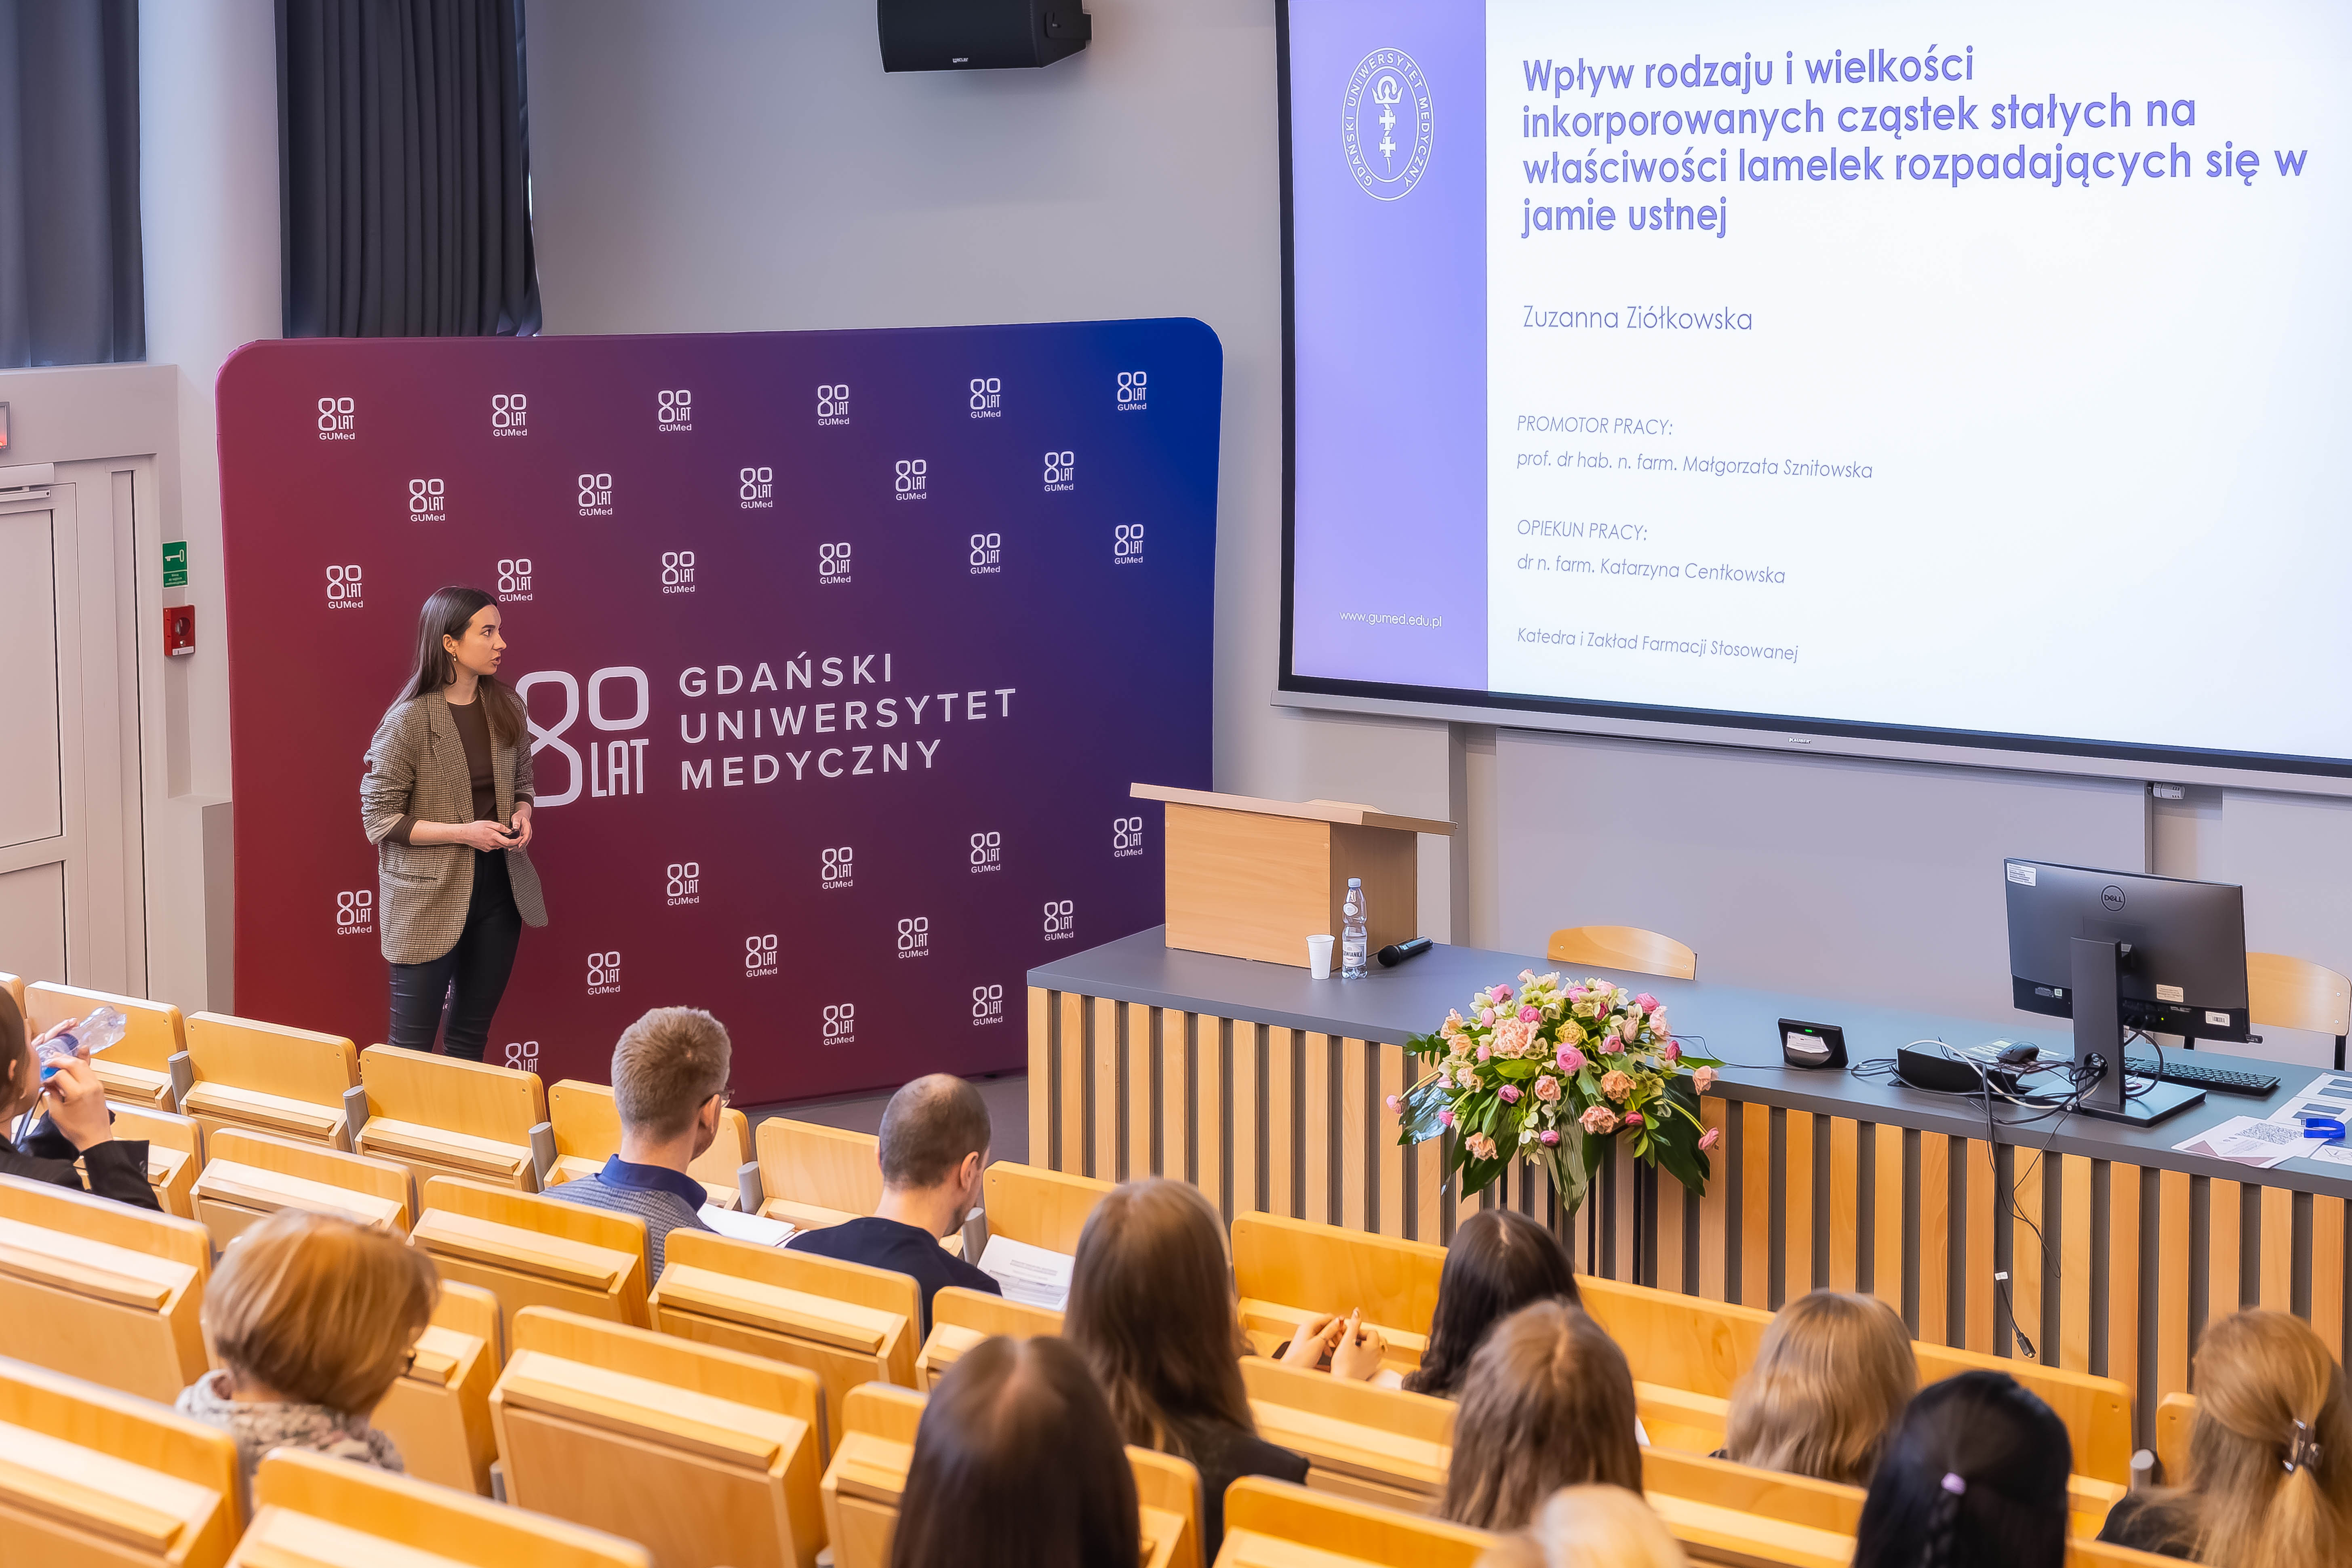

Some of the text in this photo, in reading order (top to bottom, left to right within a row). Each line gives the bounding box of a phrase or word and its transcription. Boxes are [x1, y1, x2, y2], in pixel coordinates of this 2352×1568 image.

[1523, 44, 1973, 99] Wpływ rodzaju i wielkości
[1345, 53, 1430, 187] GDAŃSKI UNIWERSYTET MEDYCZNY
[1523, 92, 2195, 144] inkorporowanych cząstek stałych na
[1522, 141, 2308, 188] właściwości lamelek rozpadających się w
[1521, 196, 1726, 239] jamie ustnej
[1524, 305, 1752, 330] Zuzanna Ziółkowska
[971, 378, 1000, 409] 80
[1118, 372, 1146, 402] 80
[1134, 387, 1146, 400] LAT
[659, 390, 691, 423] 80
[818, 385, 849, 417] 80
[835, 402, 849, 415] LAT
[987, 395, 1000, 408] LAT
[318, 398, 354, 431] 80
[493, 394, 526, 427] 80
[512, 412, 526, 425] LAT
[677, 407, 691, 421] LAT
[339, 415, 354, 429] LAT
[1517, 415, 1672, 435] PROMOTOR PRACY:
[1044, 451, 1074, 483] 80
[1517, 450, 1872, 478] prof. dr hab. n. farm. Małgorzata Sznitowska
[896, 460, 926, 492] 80
[913, 476, 926, 490] LAT
[1061, 468, 1074, 481] LAT
[579, 474, 611, 507] 80
[741, 467, 772, 500] 80
[758, 484, 772, 498] LAT
[409, 479, 444, 512] 80
[429, 497, 444, 511] LAT
[597, 491, 612, 505] LAT
[1518, 520, 1647, 541] OPIEKUN PRACY:
[1115, 524, 1143, 556] 80
[1131, 541, 1143, 554] LAT
[971, 533, 1000, 565] 80
[987, 550, 1000, 563] LAT
[662, 551, 694, 584] 80
[820, 543, 851, 575] 80
[837, 560, 850, 573] LAT
[498, 559, 531, 592] 80
[680, 568, 694, 582] LAT
[1518, 553, 1785, 583] dr n. farm. Katarzyna Centkowska
[326, 565, 361, 599] 80
[517, 577, 531, 590] LAT
[820, 576, 851, 584] GUMed
[347, 583, 362, 597] LAT
[663, 585, 695, 593] GUMed
[328, 600, 363, 608] GUMed
[499, 594, 532, 602] GUMed
[1339, 612, 1442, 629] www.gumed.edu.pl
[1518, 627, 1798, 664] Katedra i Zakład Farmacji Stosowanej
[679, 651, 891, 697] GDAŃSKI
[681, 688, 1016, 743] UNIWERSYTET
[515, 666, 649, 807] 80
[591, 739, 649, 798] LAT
[682, 739, 941, 790] MEDYCZNY
[1114, 817, 1142, 848] 80
[1130, 833, 1142, 846] LAT
[971, 832, 1000, 864] 80
[987, 848, 1000, 862] LAT
[1114, 848, 1142, 857] GUMed
[822, 847, 852, 880] 80
[839, 864, 852, 878] LAT
[971, 864, 1000, 873] GUMed
[667, 863, 699, 896] 80
[685, 880, 699, 894] LAT
[822, 880, 853, 889] GUMed
[667, 896, 699, 905] GUMed
[2104, 894, 2123, 903] DELL
[337, 890, 371, 925] 80
[356, 908, 371, 923] LAT
[1044, 901, 1073, 932] 80
[1060, 916, 1073, 930] LAT
[337, 926, 371, 934] GUMed
[898, 917, 928, 950] 80
[1045, 931, 1073, 941] GUMed
[915, 933, 928, 947] LAT
[746, 934, 777, 968] 80
[763, 951, 777, 965] LAT
[899, 949, 928, 958] GUMed
[587, 951, 620, 985] 80
[606, 969, 620, 983] LAT
[746, 967, 777, 977] GUMed
[588, 985, 620, 995] GUMed
[973, 985, 1002, 1017] 80
[990, 1000, 1002, 1014] LAT
[823, 1004, 854, 1037] 80
[840, 1020, 854, 1034] LAT
[973, 1016, 1002, 1025] GUMed
[824, 1035, 854, 1045] GUMed
